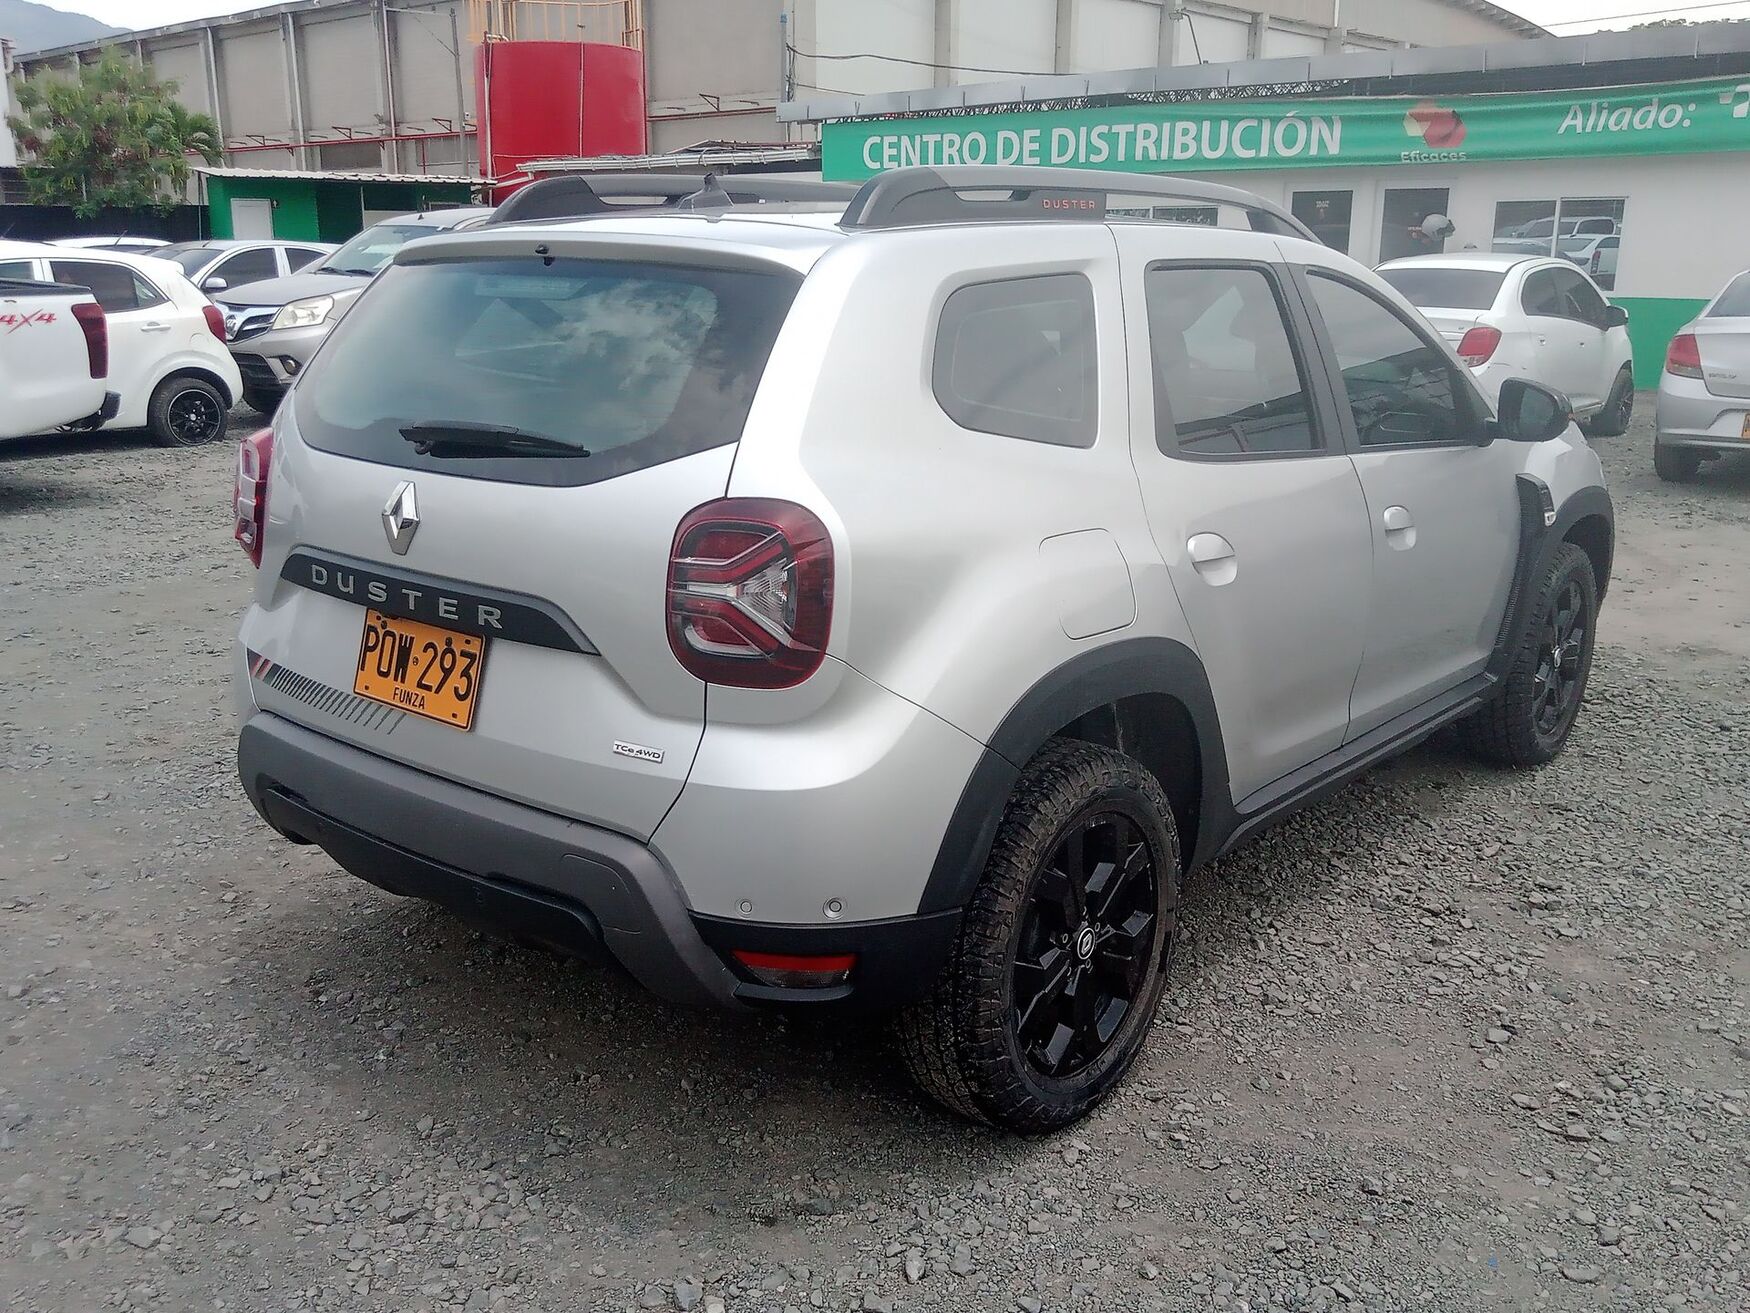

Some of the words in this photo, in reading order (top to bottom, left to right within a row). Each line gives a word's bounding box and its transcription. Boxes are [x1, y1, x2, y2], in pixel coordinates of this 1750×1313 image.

[1557, 98, 1697, 135] Aliado:
[862, 131, 987, 170] CENTRO
[996, 129, 1041, 166] DE
[1050, 110, 1342, 165] DISTRIBUCIÓN
[1400, 150, 1468, 164] Eficaces
[1042, 199, 1096, 210] DUSTER
[310, 564, 503, 629] DUSTER
[392, 686, 426, 710] FUNZA
